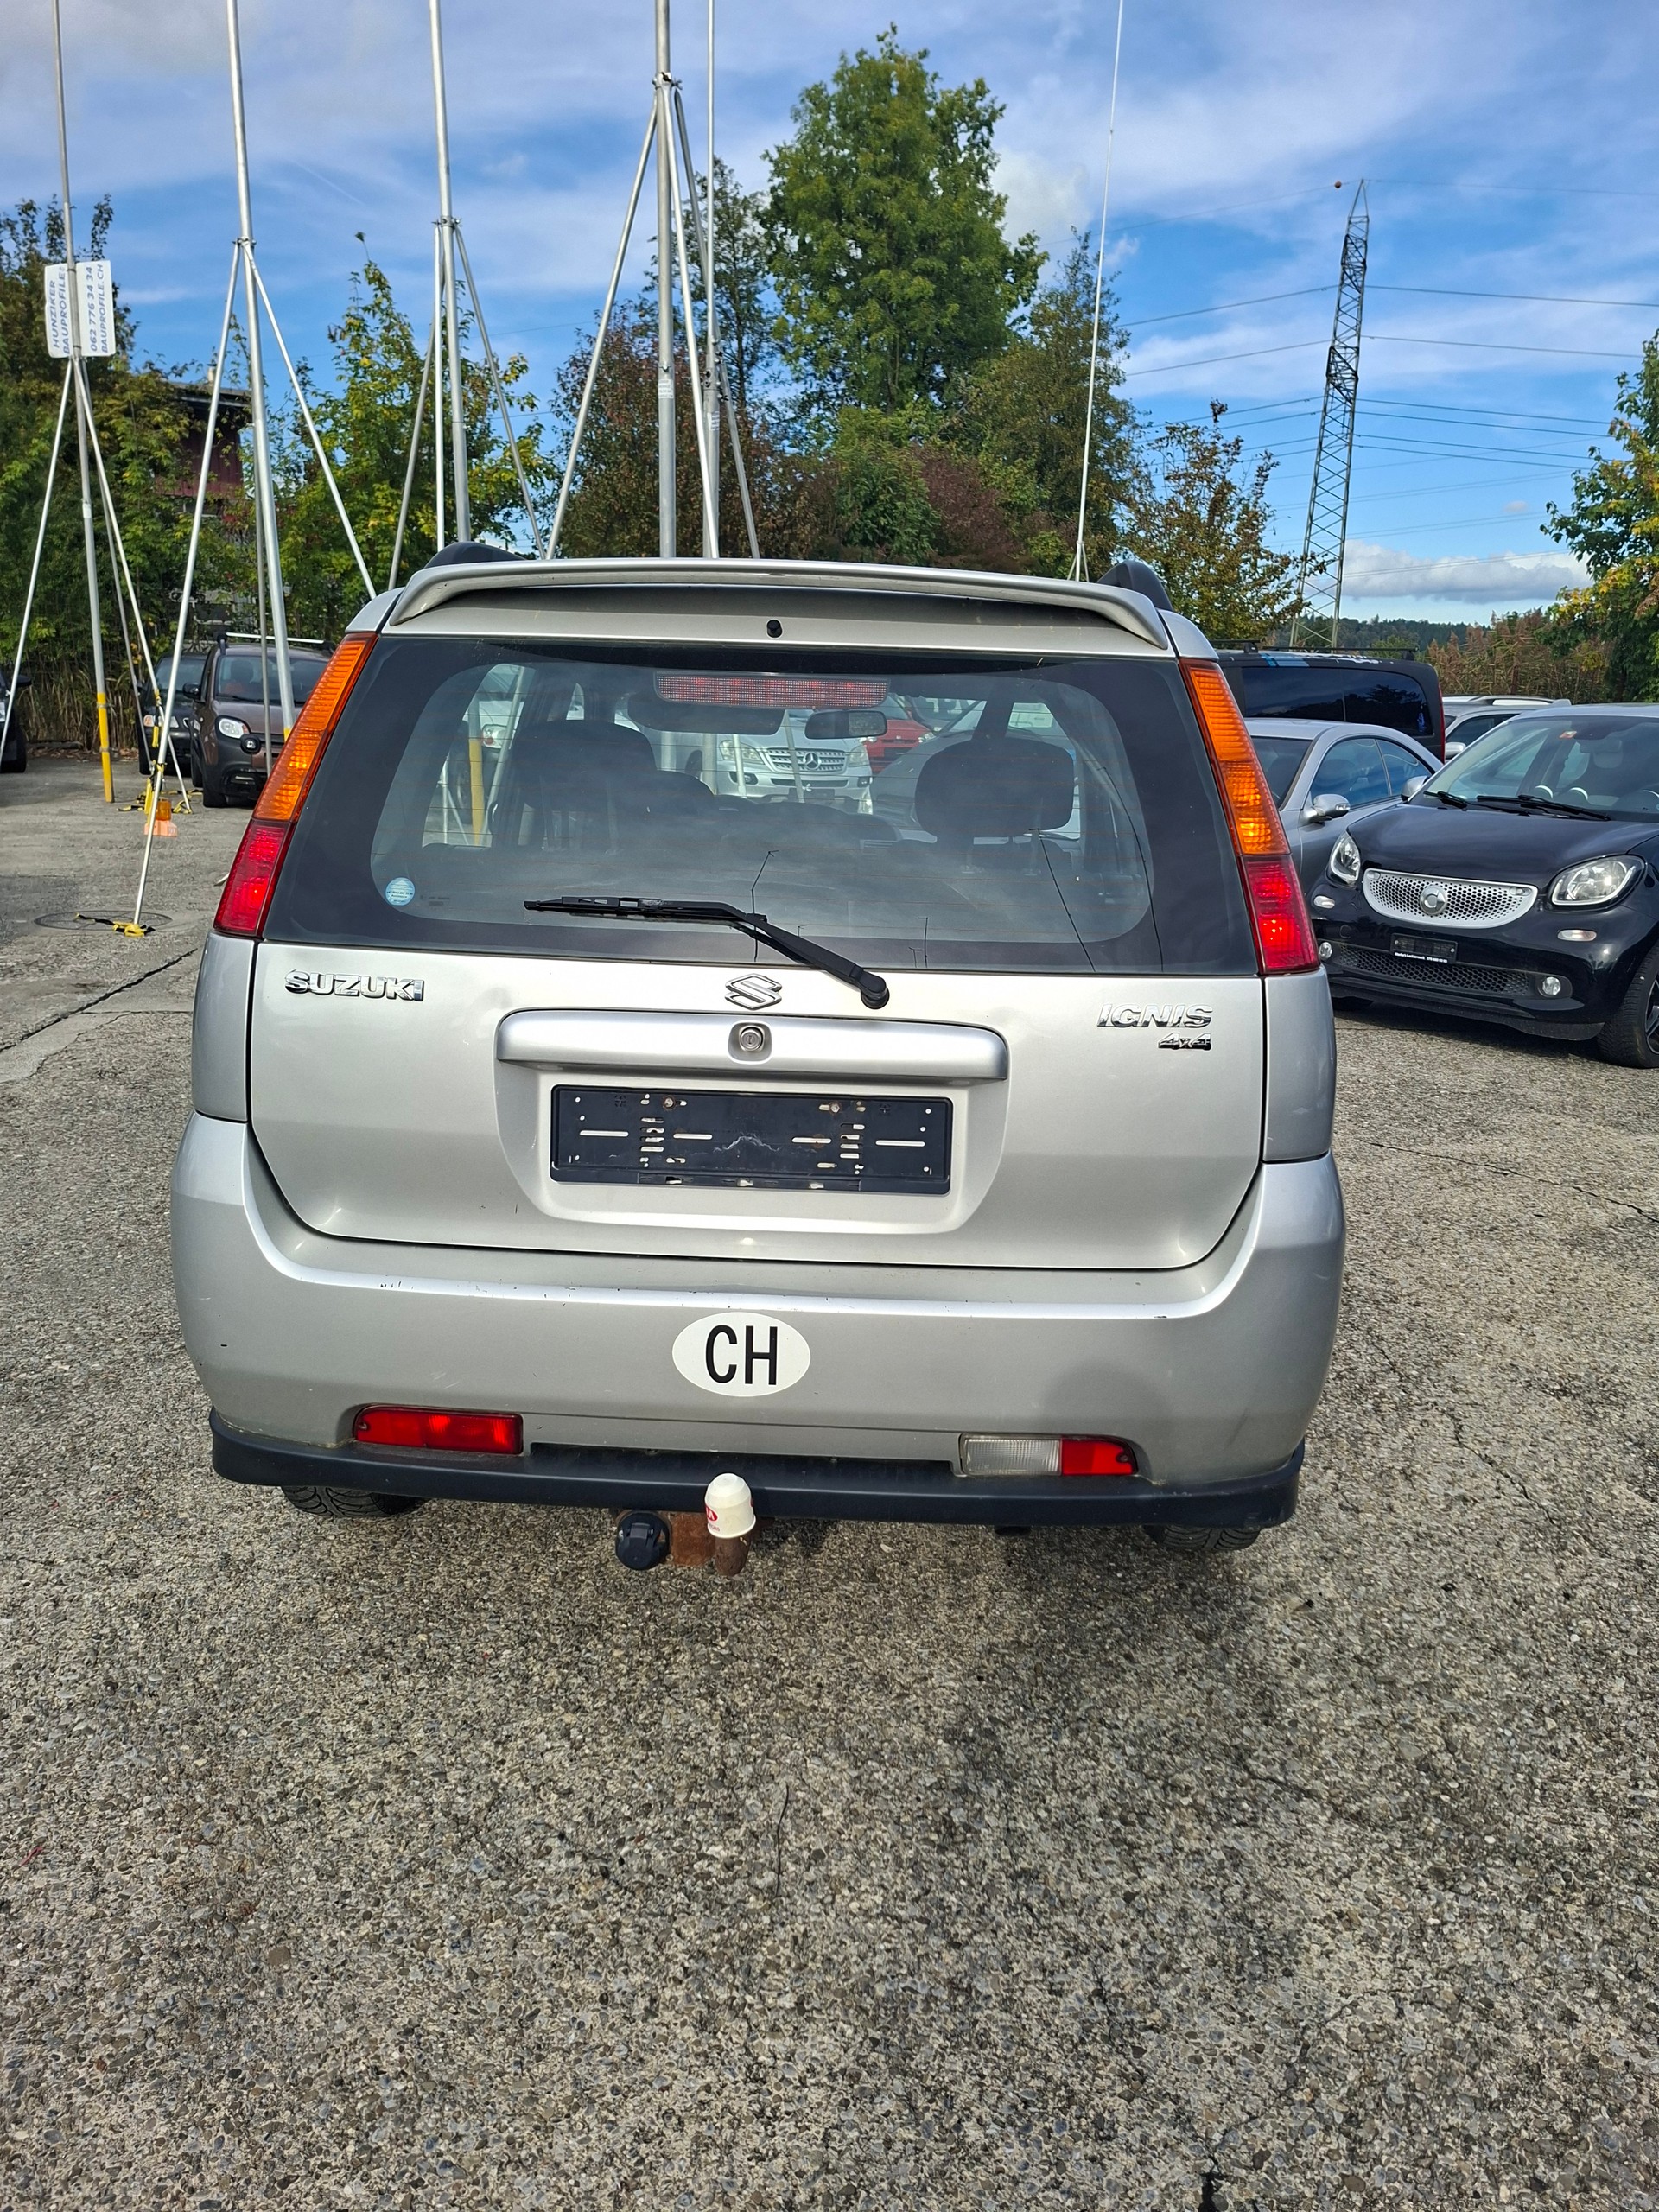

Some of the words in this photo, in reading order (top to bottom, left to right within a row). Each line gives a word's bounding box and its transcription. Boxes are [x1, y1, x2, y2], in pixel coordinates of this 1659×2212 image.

[86, 266, 93, 281] 34
[87, 284, 95, 300] 34
[49, 280, 60, 348] HUNZIKER
[97, 264, 108, 353] BAUPROFILE.CH
[285, 969, 425, 1001] SUZUKI
[1096, 1003, 1213, 1028] IGNIS
[1158, 1032, 1212, 1051] 4x4
[705, 1325, 778, 1385] CH
